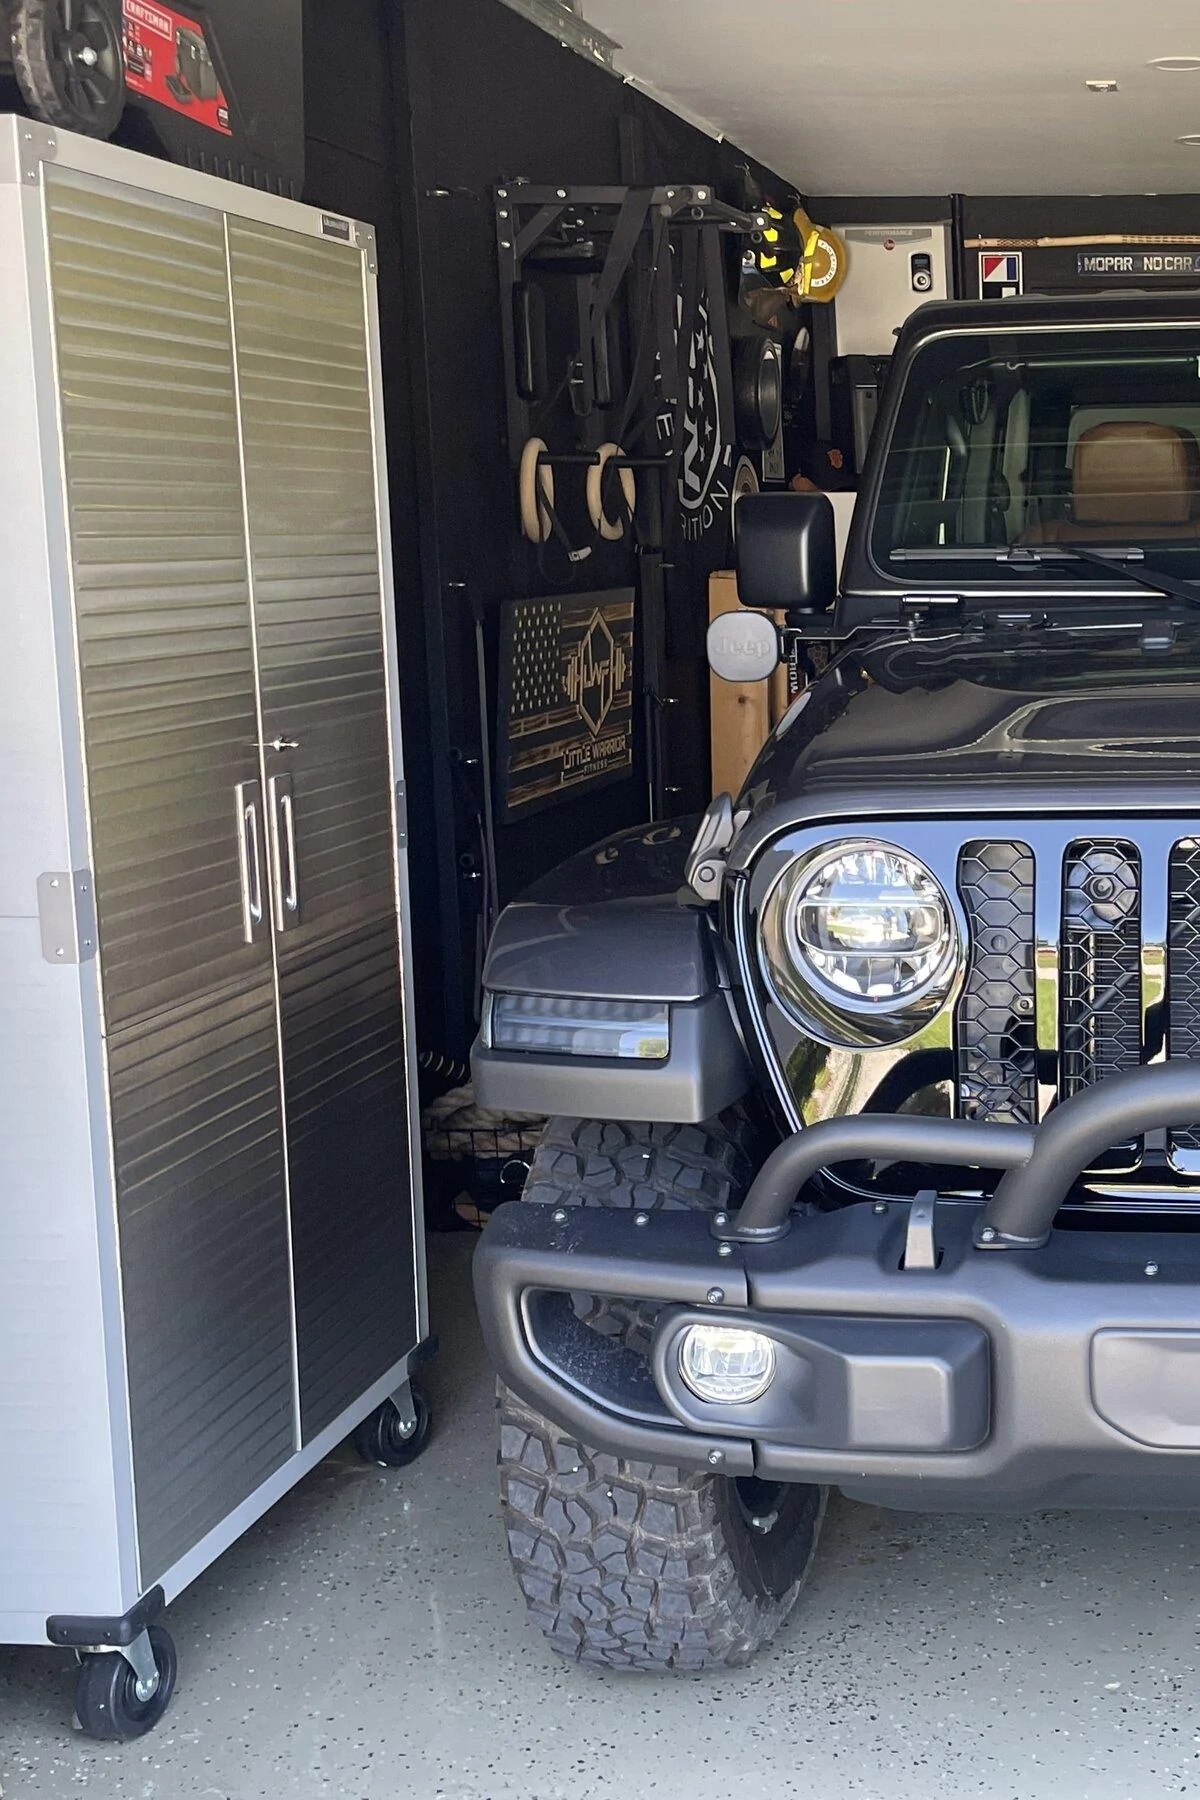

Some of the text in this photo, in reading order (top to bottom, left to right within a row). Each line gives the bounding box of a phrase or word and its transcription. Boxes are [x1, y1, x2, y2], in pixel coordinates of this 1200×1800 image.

[1084, 256, 1133, 272] MOPAR
[715, 638, 770, 659] Jeep
[564, 735, 627, 769] LITTLE WARRIOR
[584, 758, 608, 775] FITNESS
